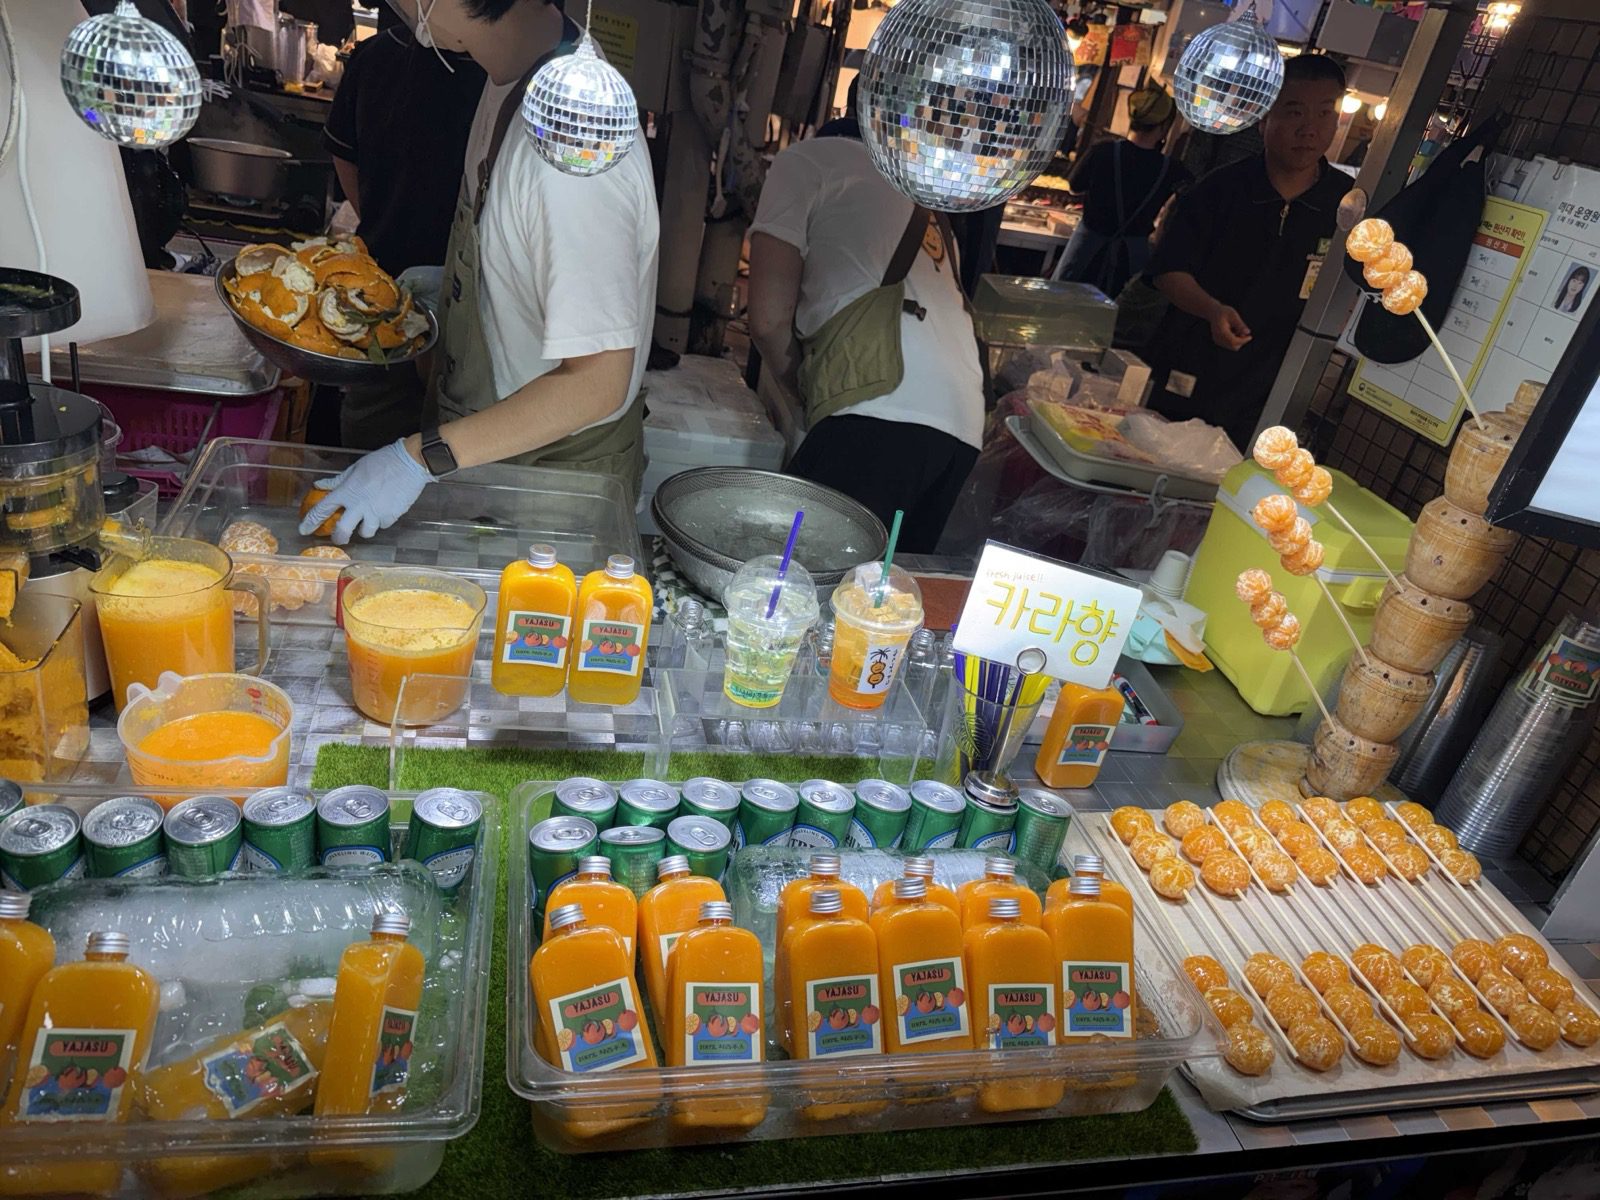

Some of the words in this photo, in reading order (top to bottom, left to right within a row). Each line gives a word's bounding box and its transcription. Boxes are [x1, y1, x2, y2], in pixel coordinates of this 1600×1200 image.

[524, 617, 554, 627] YAJASU
[985, 580, 1120, 667] 카라향
[599, 626, 628, 635] YAJASU
[911, 969, 944, 983] YAJASU
[1079, 970, 1111, 980] YAJASU
[824, 985, 860, 998] YAJASU
[704, 992, 739, 1003] YAJASU
[1004, 993, 1036, 1002] YAJASU
[572, 994, 612, 1014] YAJASU
[62, 1041, 110, 1053] YAJASU
